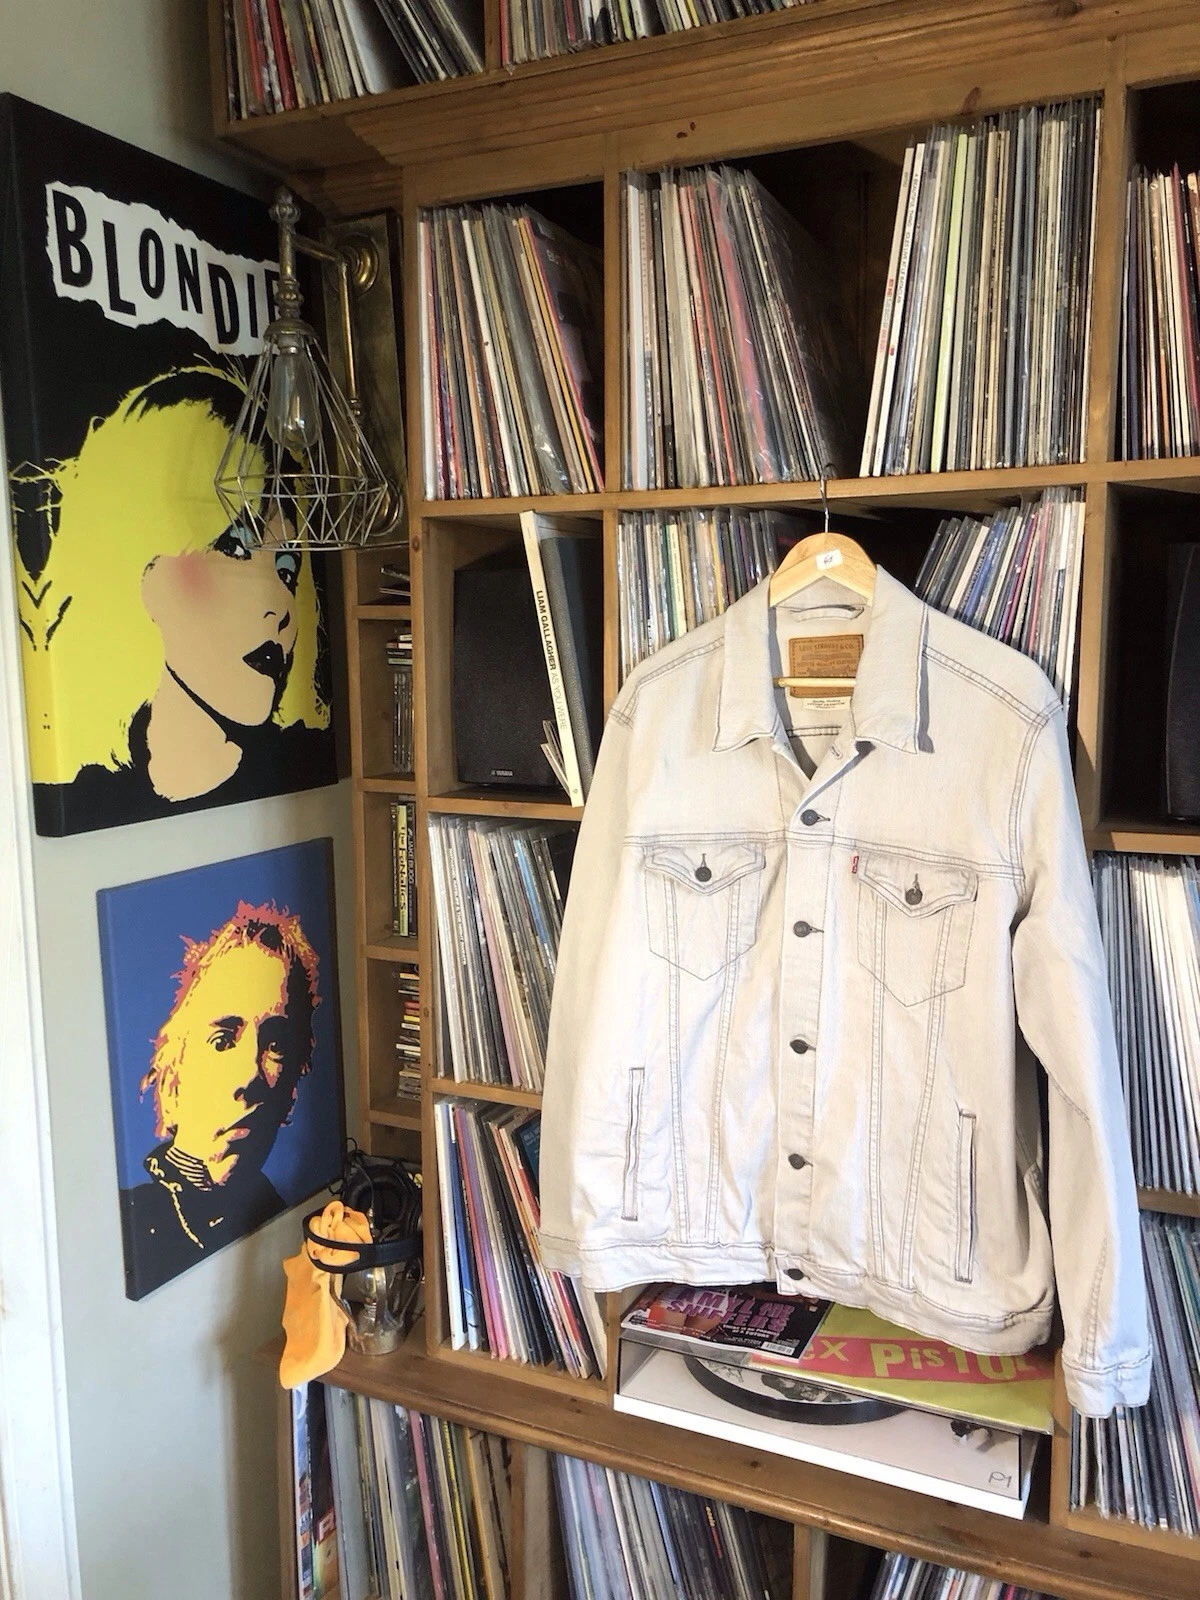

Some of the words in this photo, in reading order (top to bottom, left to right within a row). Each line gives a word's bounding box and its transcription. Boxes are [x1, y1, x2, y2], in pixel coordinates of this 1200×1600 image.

[536, 590, 547, 614] LIAM
[541, 615, 557, 670] GALLAGHER
[551, 672, 560, 684] AS
[553, 686, 563, 704] YOU
[556, 705, 568, 730] WERE
[676, 1288, 757, 1315] AMYL
[666, 1301, 789, 1331] SNIFFERS
[801, 1339, 850, 1362] ex
